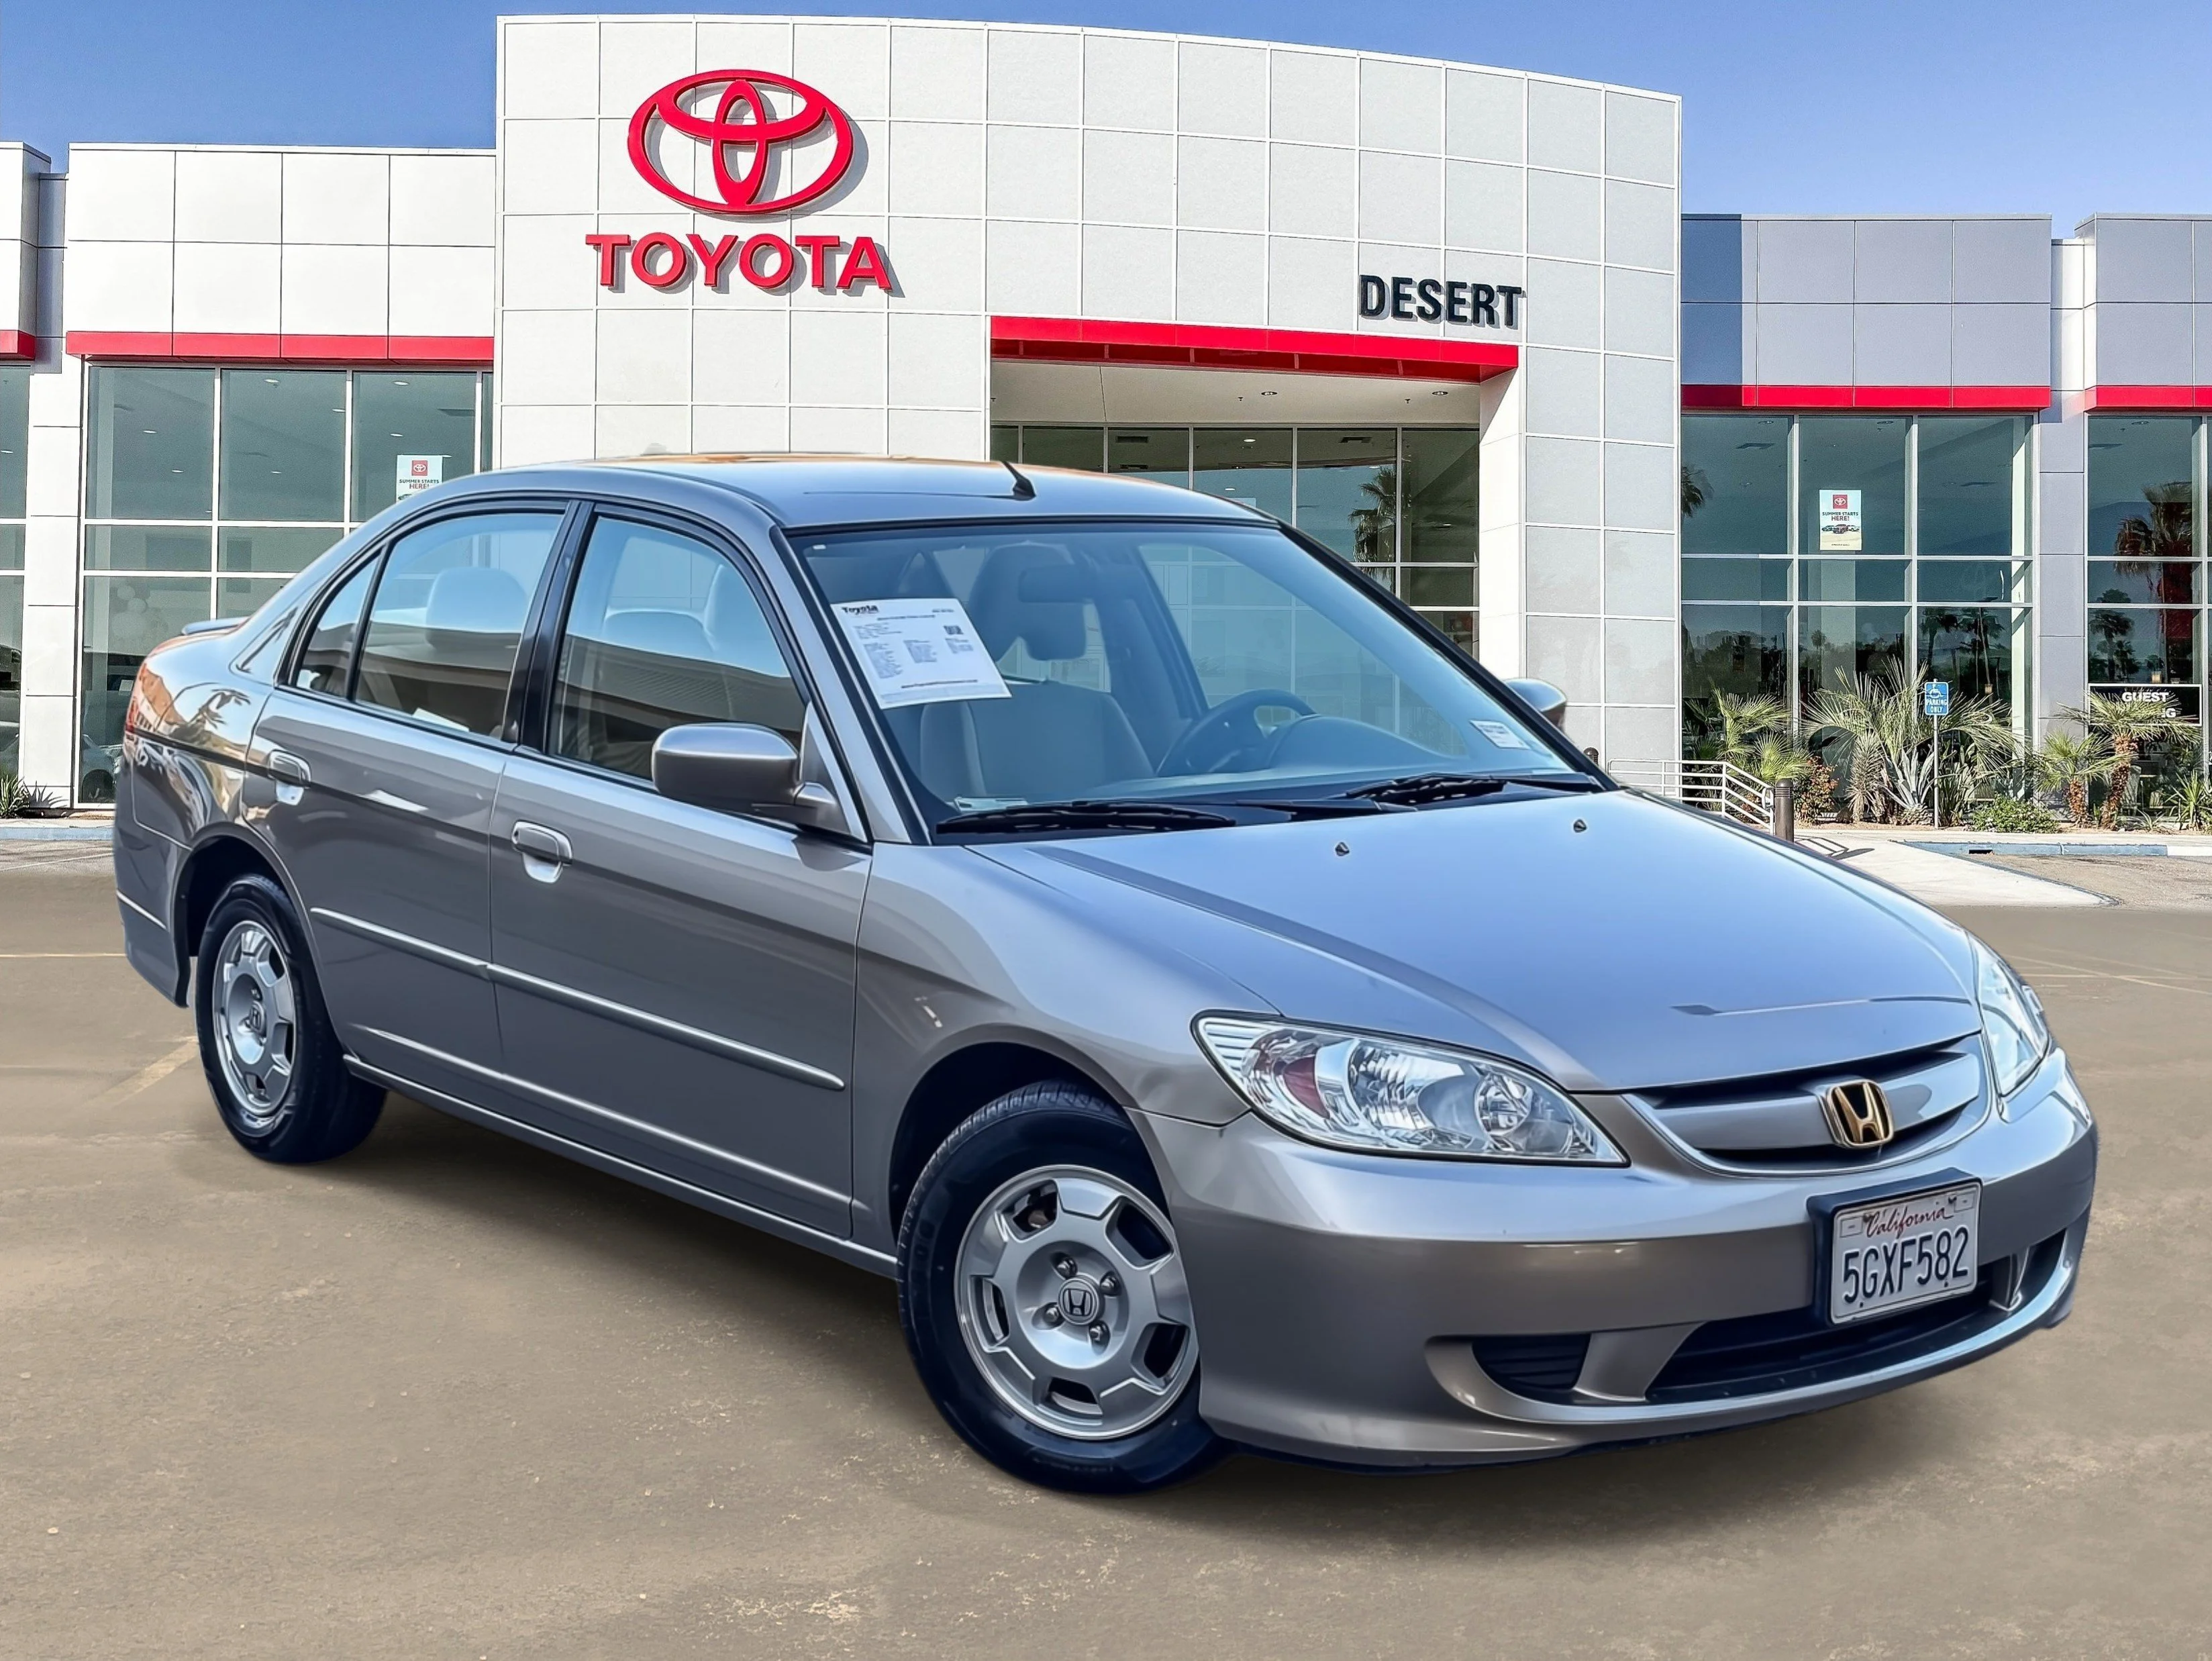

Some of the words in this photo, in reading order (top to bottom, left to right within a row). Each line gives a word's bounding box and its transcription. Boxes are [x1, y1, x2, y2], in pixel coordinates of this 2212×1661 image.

[585, 232, 892, 291] TOYOTA
[1359, 274, 1522, 327] DESERT
[842, 605, 879, 615] Toyota
[2121, 691, 2170, 703] GUEST
[1866, 1205, 1955, 1239] California
[1844, 1226, 1969, 1304] 5GXF582
